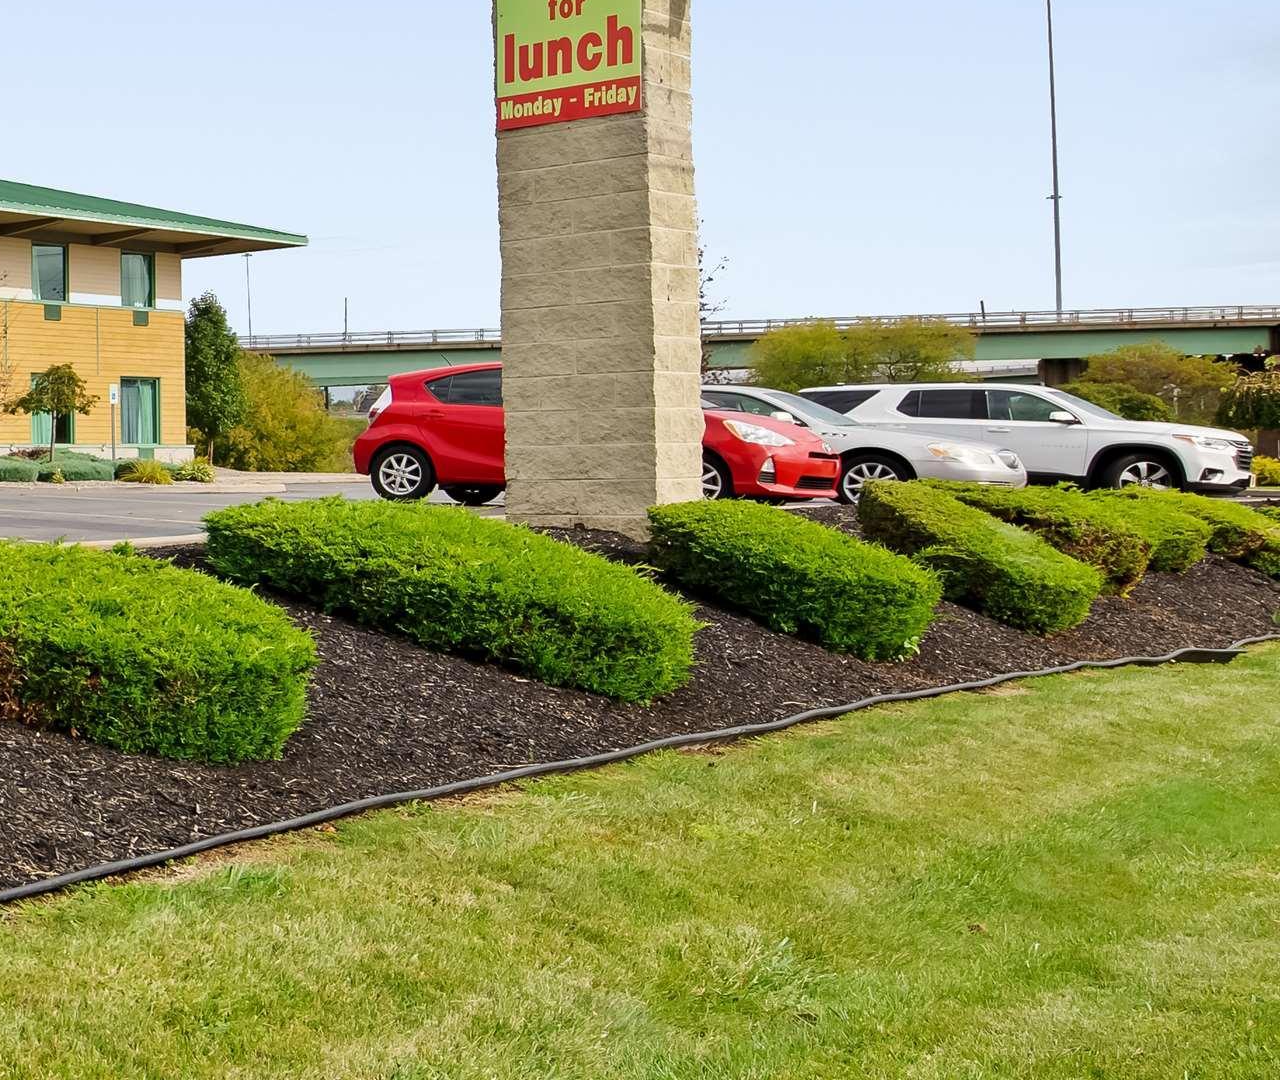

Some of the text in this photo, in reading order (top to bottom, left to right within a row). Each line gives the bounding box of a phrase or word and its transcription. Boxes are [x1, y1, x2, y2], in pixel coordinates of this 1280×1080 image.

[503, 14, 634, 85] lunch
[500, 96, 563, 120] Monday
[583, 85, 638, 108] Friday
